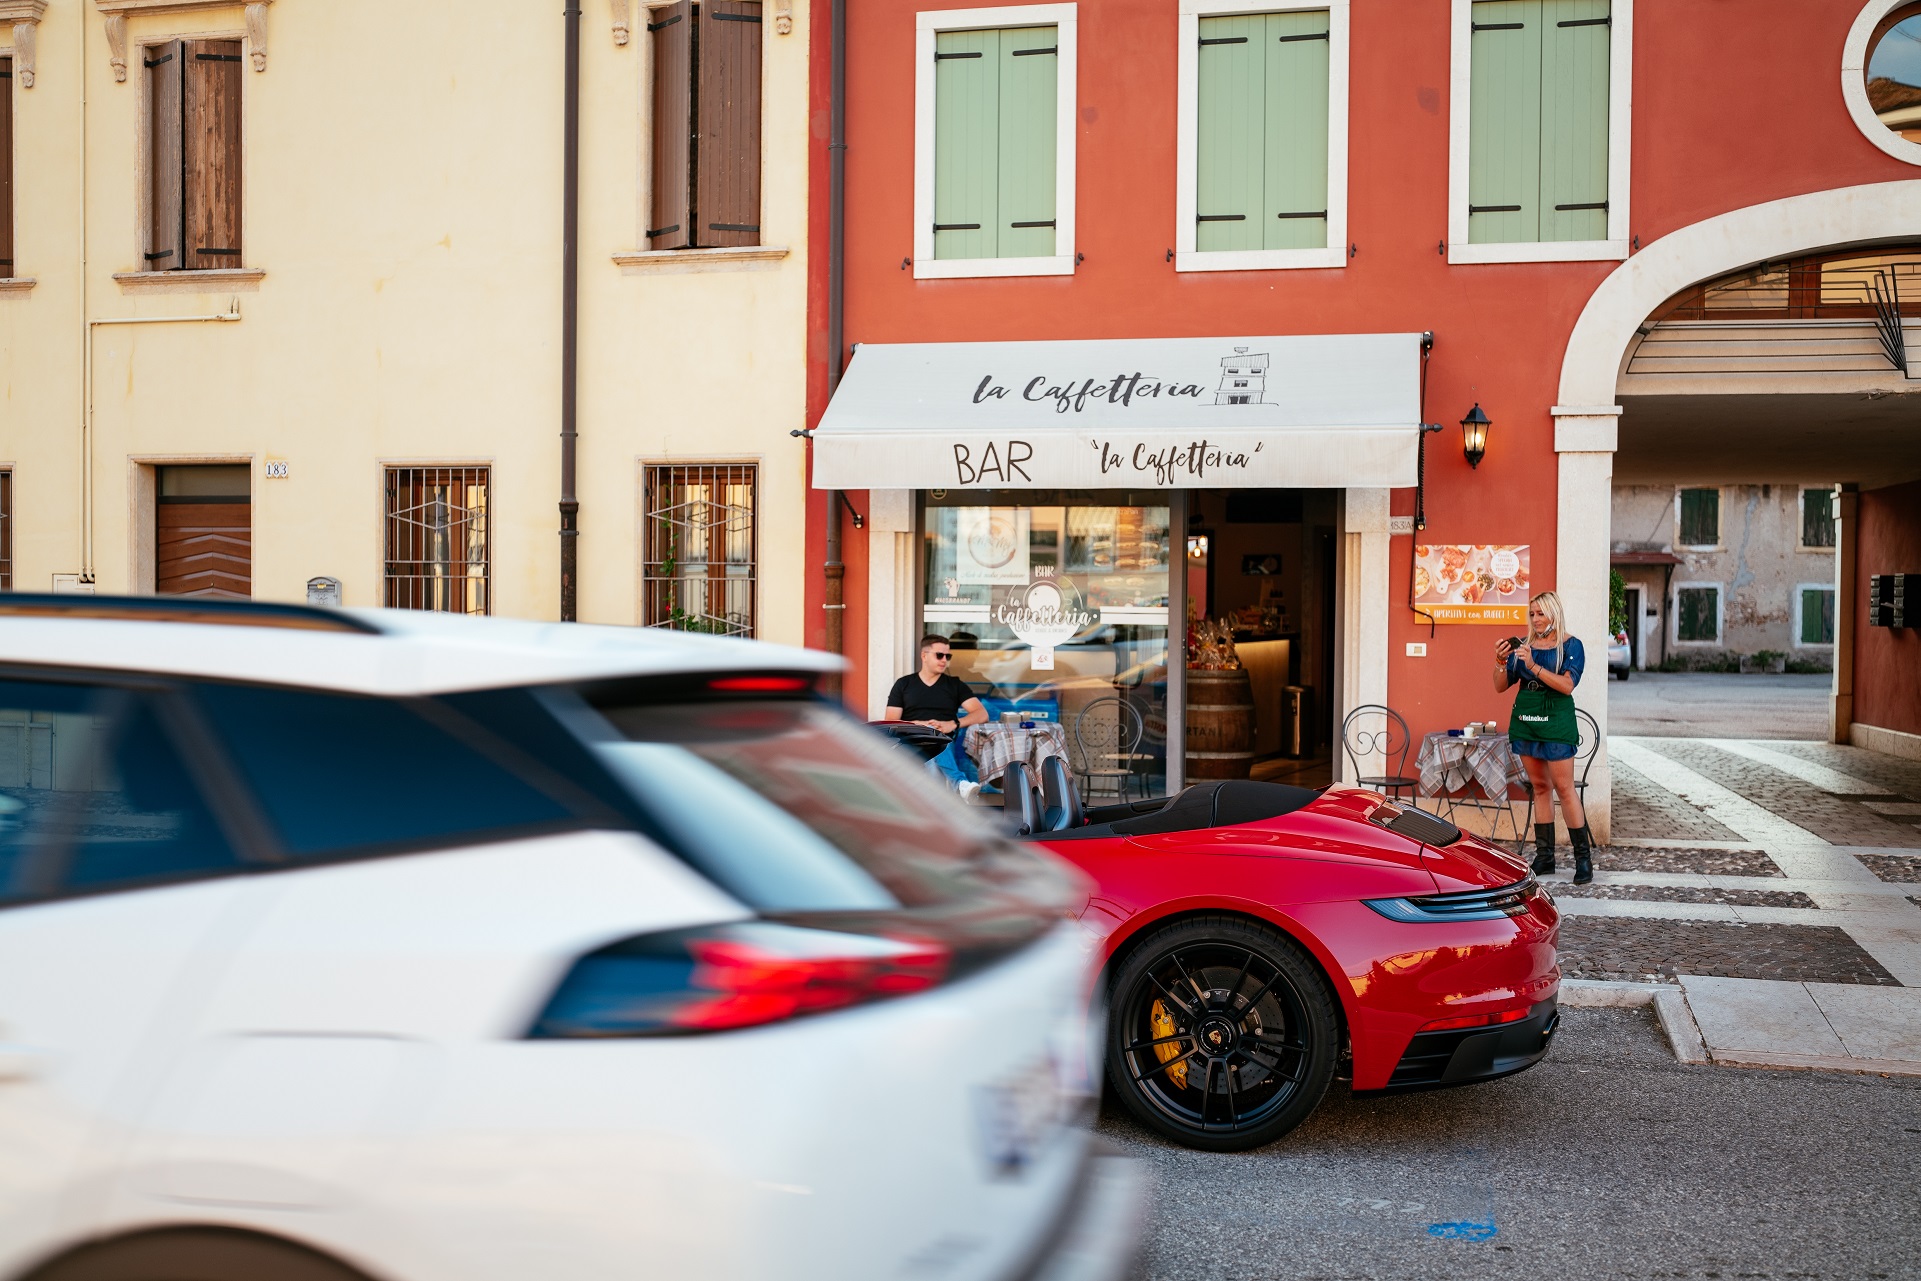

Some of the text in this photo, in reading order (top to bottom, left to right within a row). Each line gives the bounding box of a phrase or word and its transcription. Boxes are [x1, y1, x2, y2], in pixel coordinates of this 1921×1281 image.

[972, 372, 1205, 413] la Caffetteria
[267, 464, 287, 475] 183
[953, 440, 1034, 485] BAR
[1034, 565, 1055, 578] BAR
[1010, 596, 1021, 608] la
[996, 604, 1092, 633] Caffetteria
